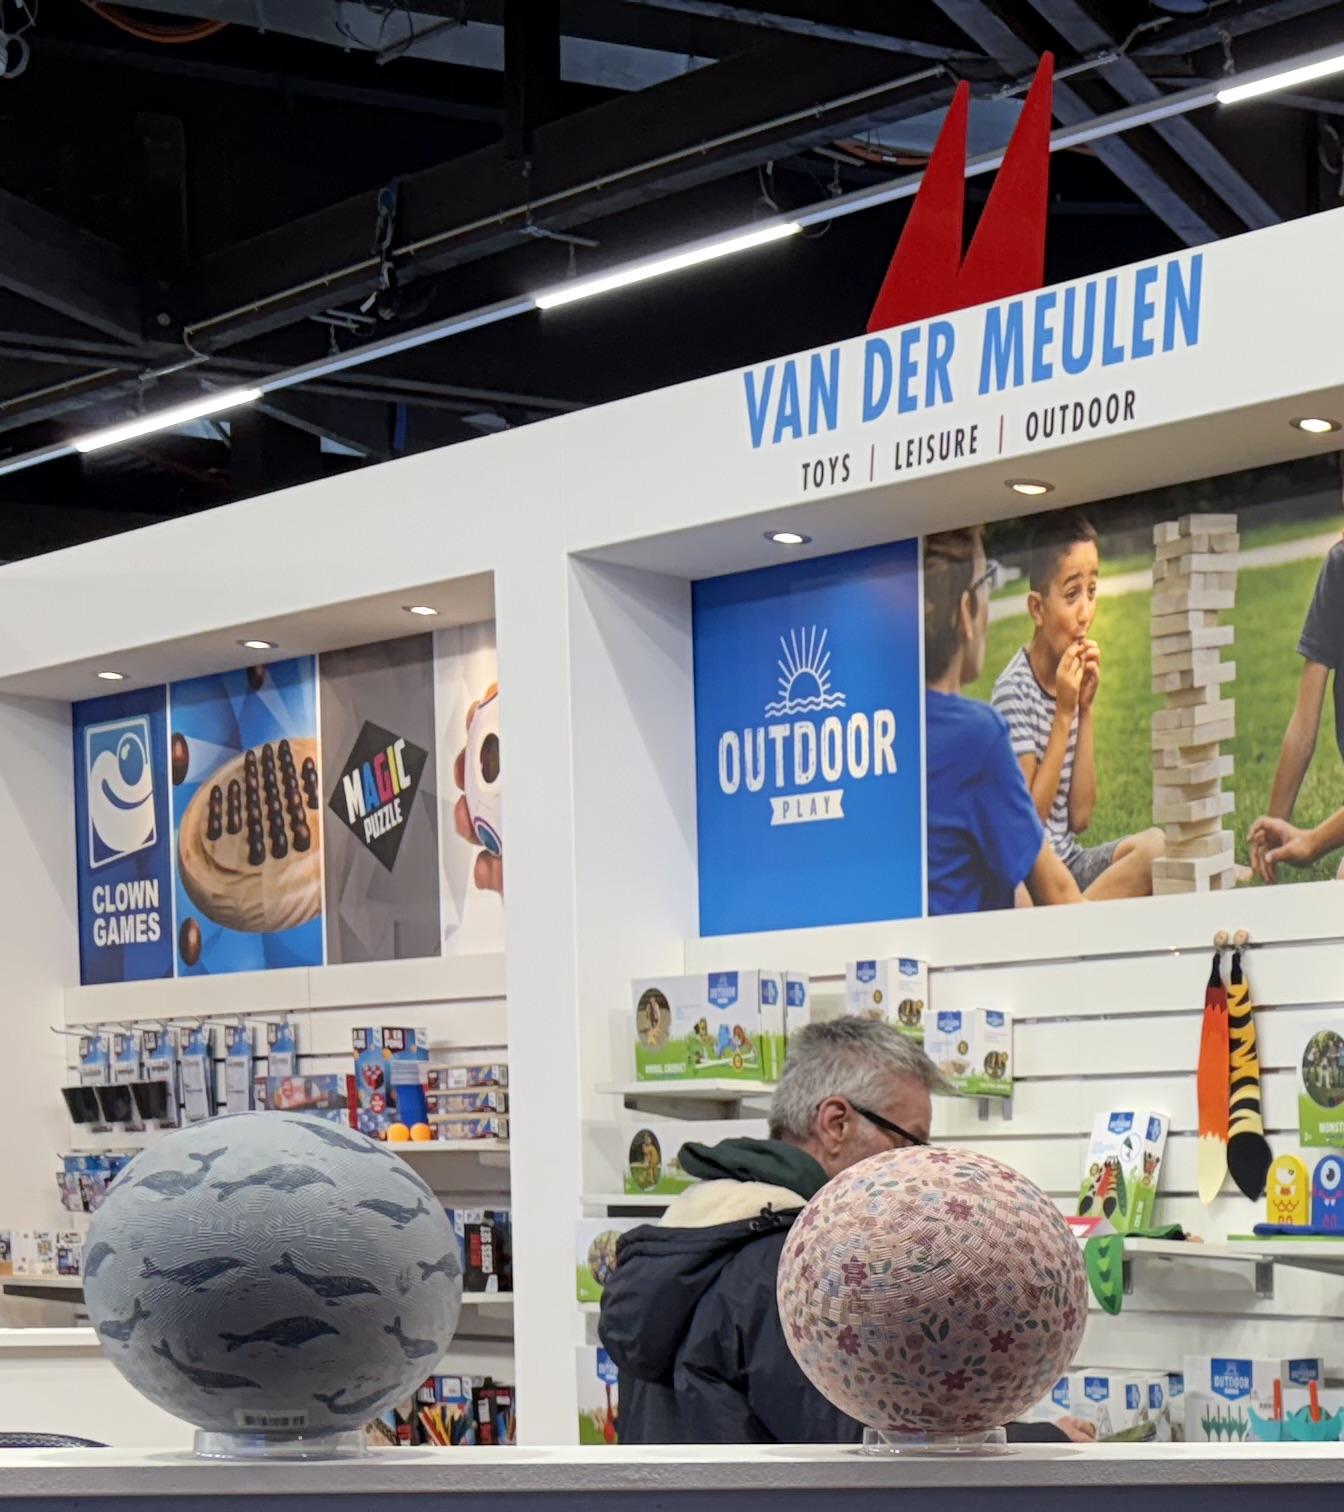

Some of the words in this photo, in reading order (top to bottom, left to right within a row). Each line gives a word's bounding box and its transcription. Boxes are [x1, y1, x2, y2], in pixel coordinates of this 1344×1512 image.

[743, 352, 840, 448] VAN
[863, 321, 956, 423] DER
[978, 253, 1205, 395] MEULEN
[802, 452, 851, 492] TOYS
[894, 424, 979, 472] LEISURE
[1025, 390, 1137, 443] OUTDOOR
[718, 709, 897, 795] OUTDOOR
[342, 739, 413, 825] MAGIC
[364, 798, 403, 844] PUZZLE
[782, 799, 833, 820] PLAY
[92, 878, 160, 914] CLOWN
[93, 913, 161, 947] GAMES
[1214, 1375, 1250, 1389] OUTDOOR
